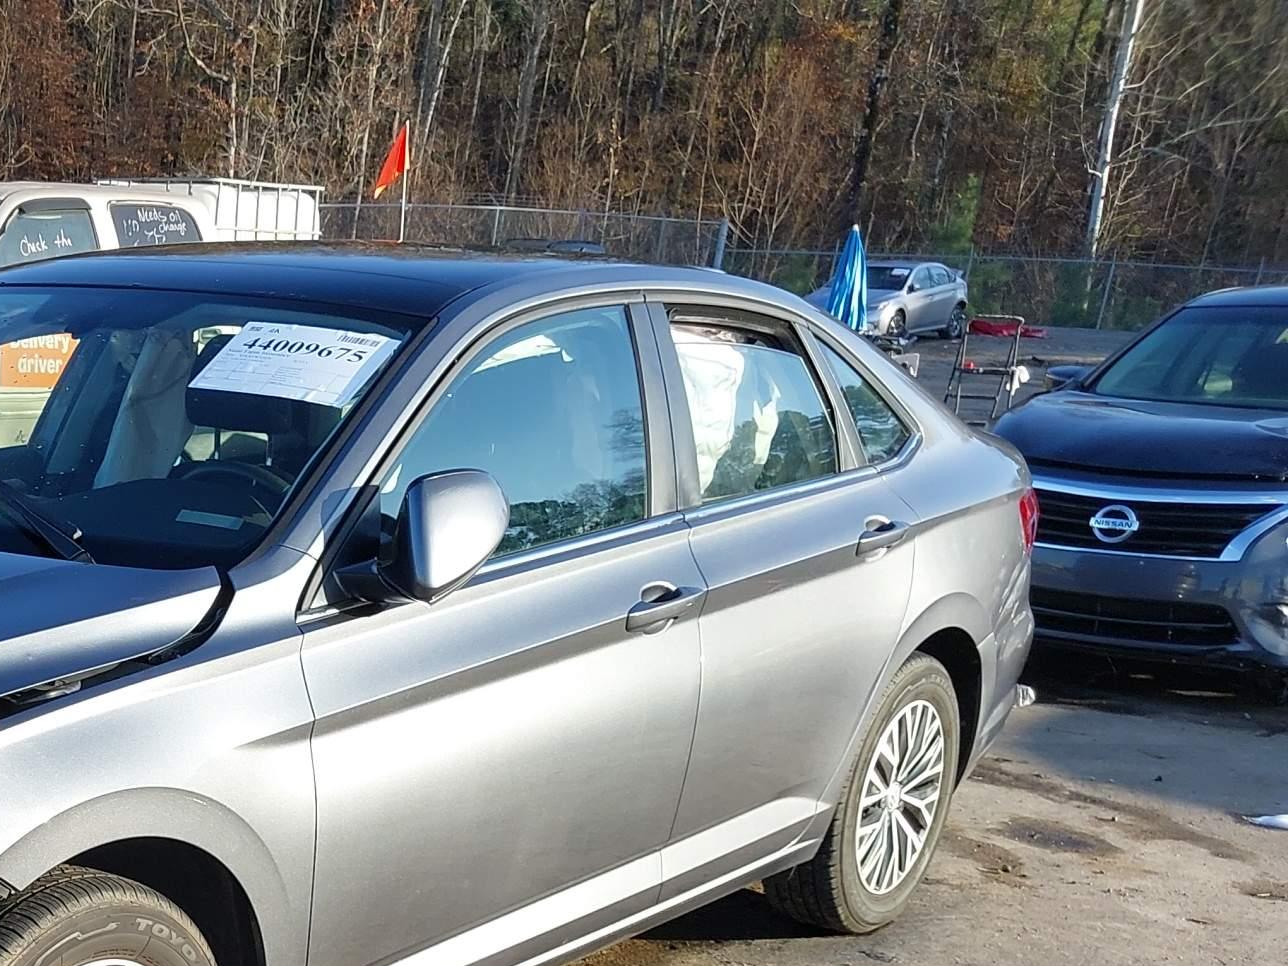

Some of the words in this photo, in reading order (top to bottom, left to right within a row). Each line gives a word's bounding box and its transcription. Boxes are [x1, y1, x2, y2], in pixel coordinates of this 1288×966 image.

[137, 207, 167, 222] Needs
[169, 209, 182, 222] oil
[20, 233, 48, 256] Check
[243, 337, 368, 363] 44009675
[17, 353, 63, 374] driver
[1094, 519, 1132, 529] NISSAN
[135, 918, 199, 963] TOYO
